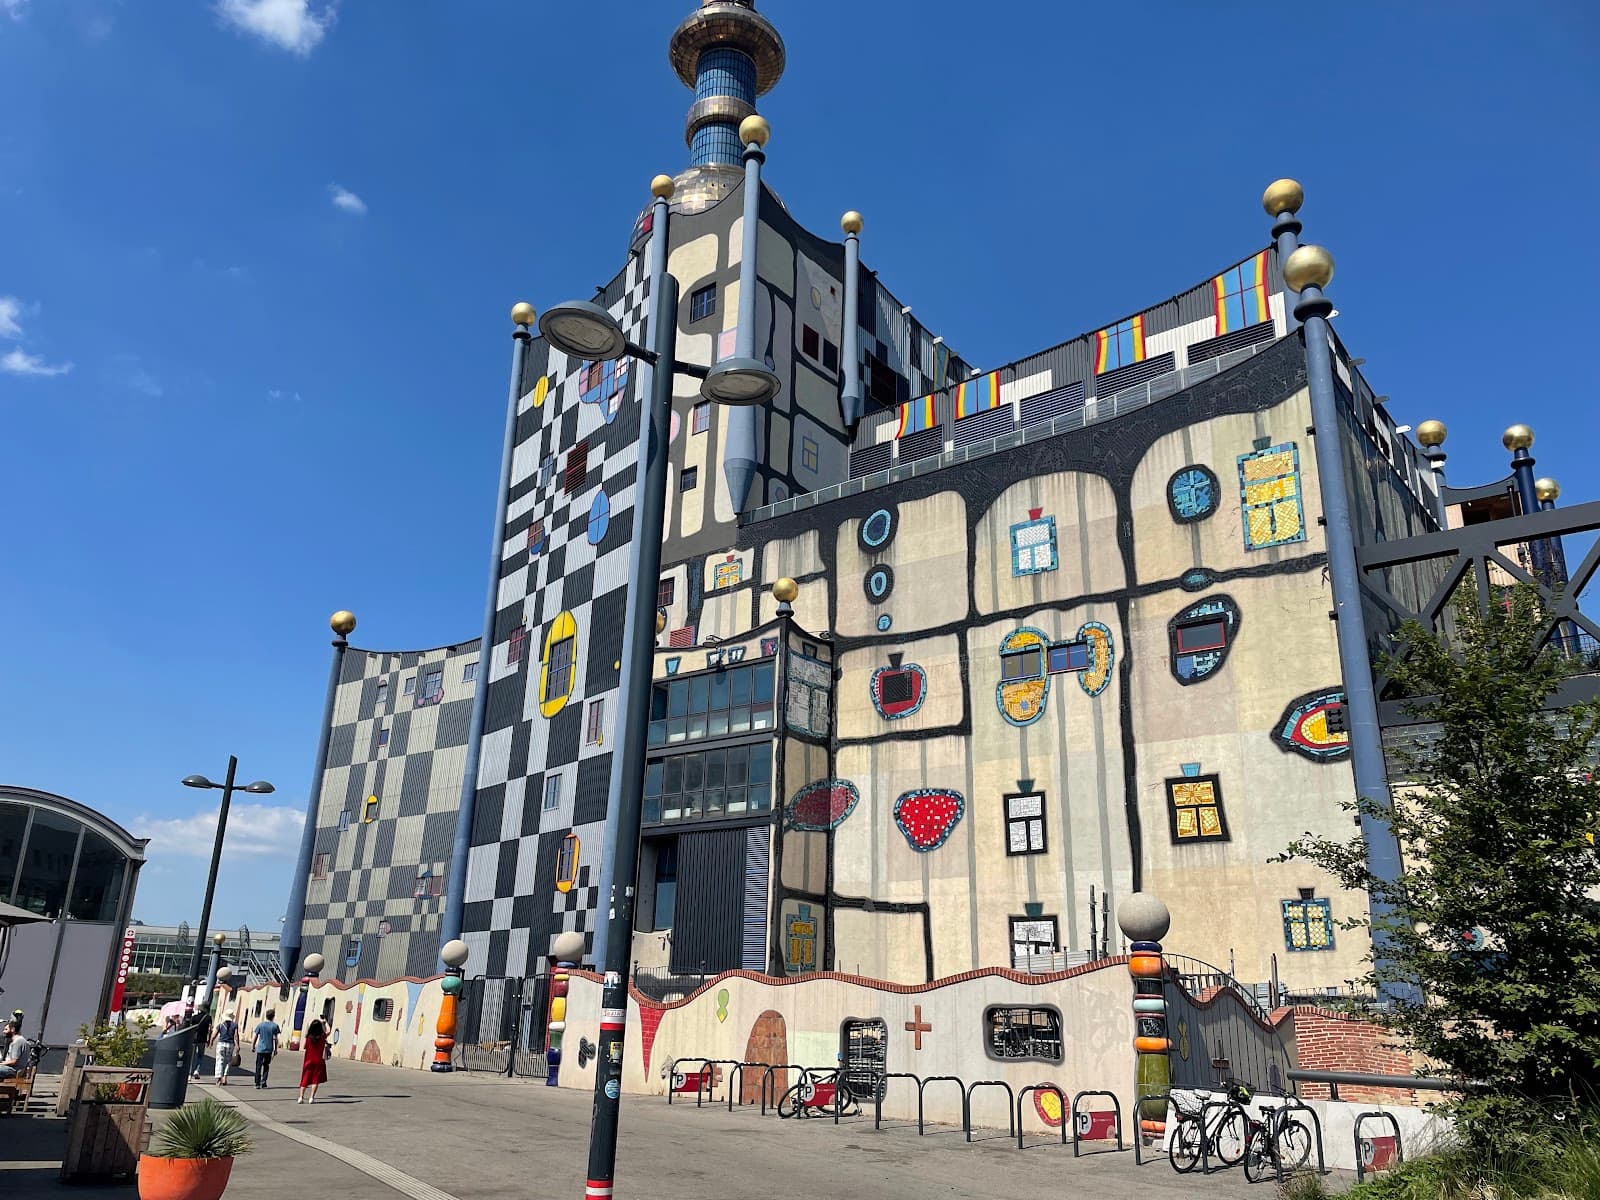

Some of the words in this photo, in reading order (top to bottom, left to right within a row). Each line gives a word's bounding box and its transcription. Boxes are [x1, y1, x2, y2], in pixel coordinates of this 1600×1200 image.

[676, 1074, 684, 1086] P
[805, 1086, 812, 1098] P
[1081, 1115, 1088, 1130] P
[1364, 1142, 1371, 1160] P
